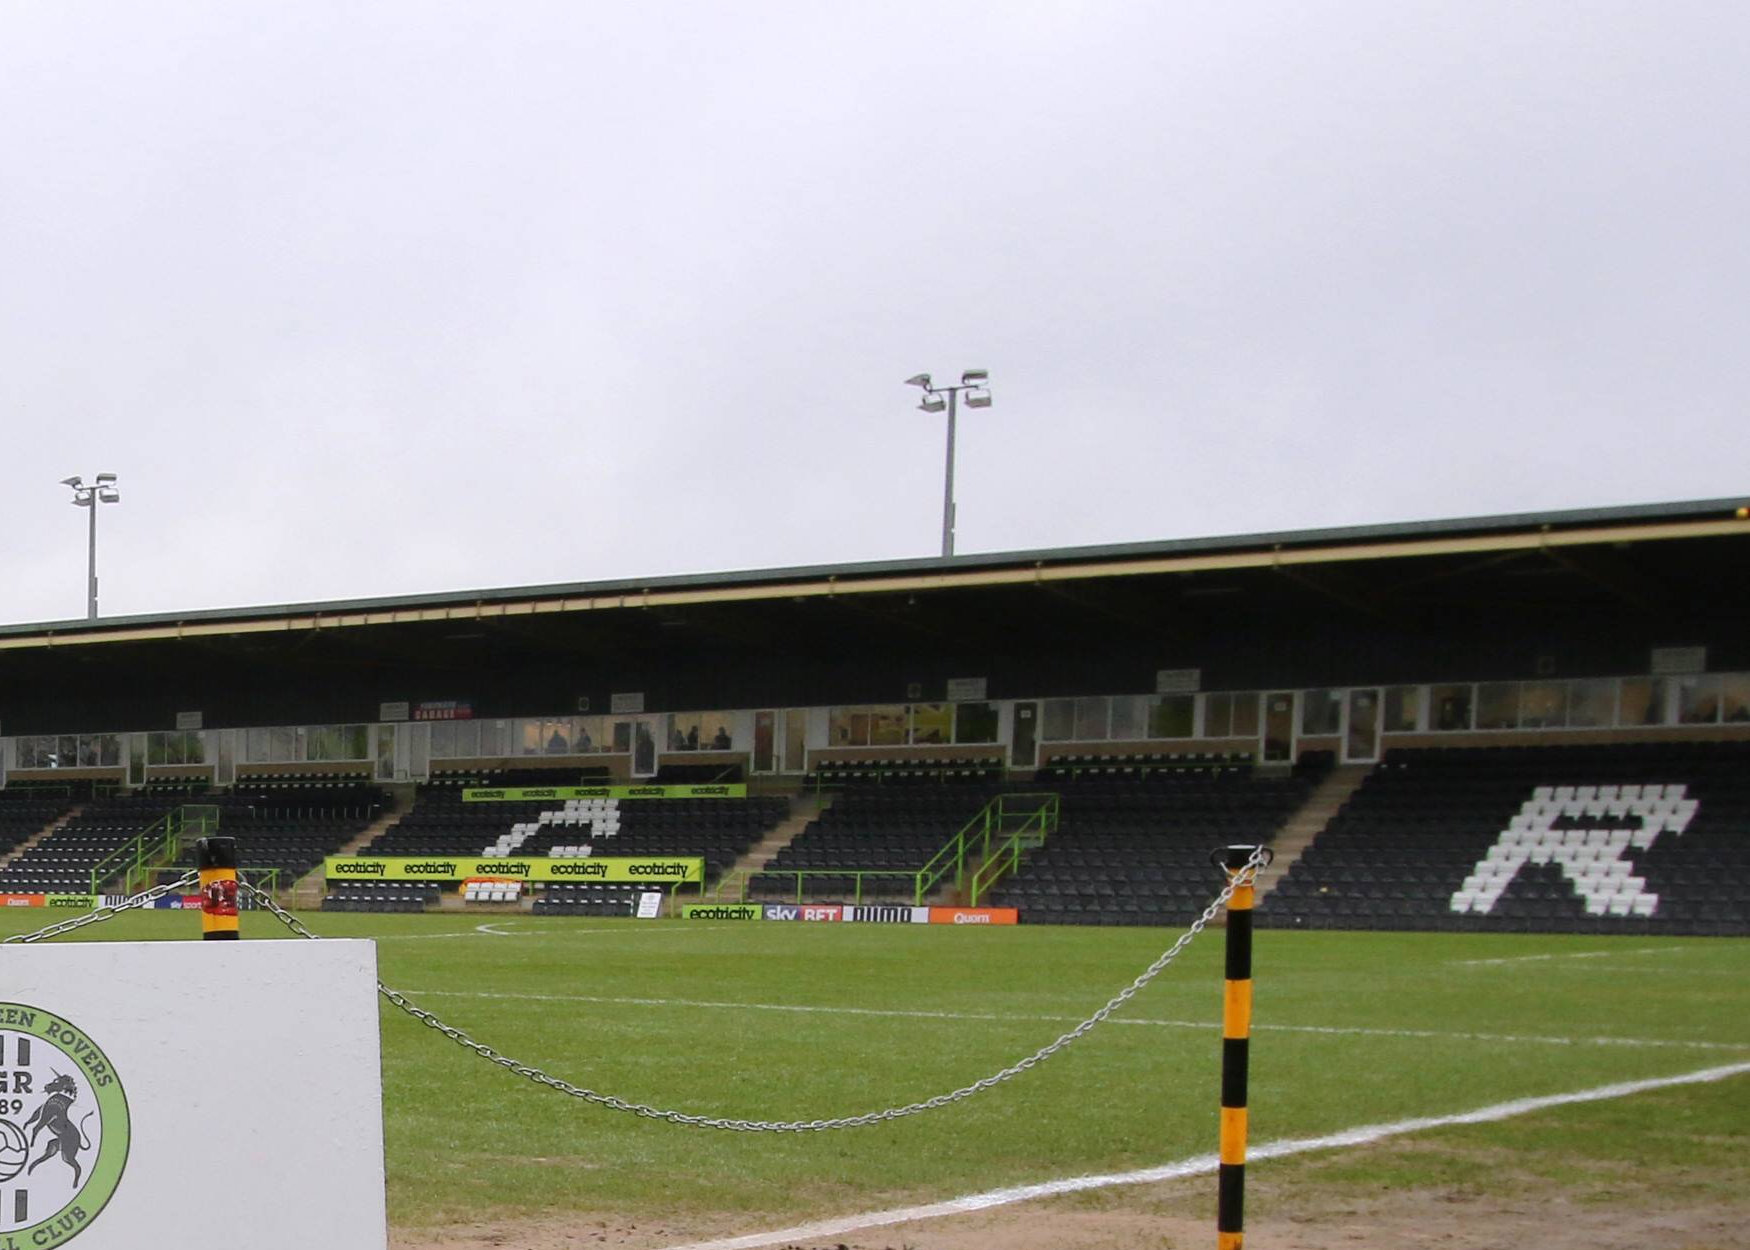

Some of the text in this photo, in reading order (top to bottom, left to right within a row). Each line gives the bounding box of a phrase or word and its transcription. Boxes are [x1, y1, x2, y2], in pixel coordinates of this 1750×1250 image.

[335, 861, 689, 878] ecotricity ecotricity ecotricity ecotricity ecotricity
[690, 906, 755, 921] ecotricity
[766, 905, 798, 921] sky
[954, 912, 990, 924] Quorn
[44, 1020, 113, 1088] ROVERS
[31, 1205, 88, 1247] CLUB
